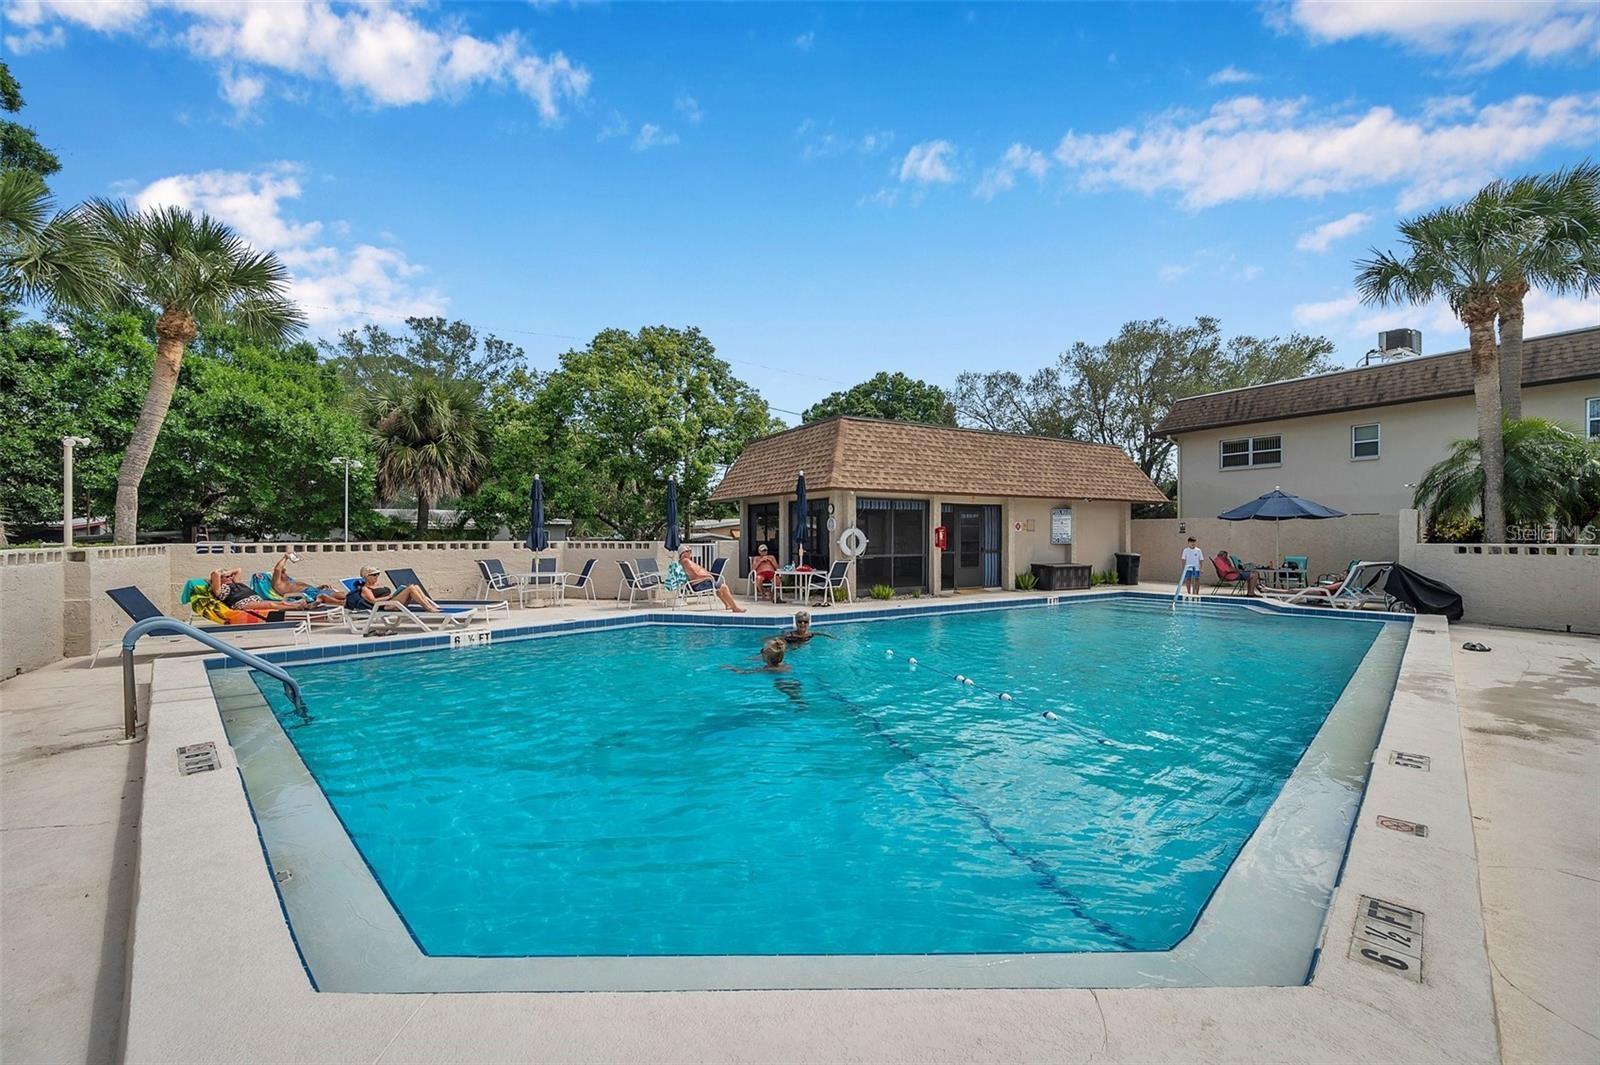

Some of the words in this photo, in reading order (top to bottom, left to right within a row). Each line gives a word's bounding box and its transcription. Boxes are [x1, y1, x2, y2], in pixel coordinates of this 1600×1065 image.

[454, 635, 461, 644] 6
[479, 633, 490, 641] FT
[1367, 900, 1413, 929] FT
[1361, 949, 1409, 970] 6
